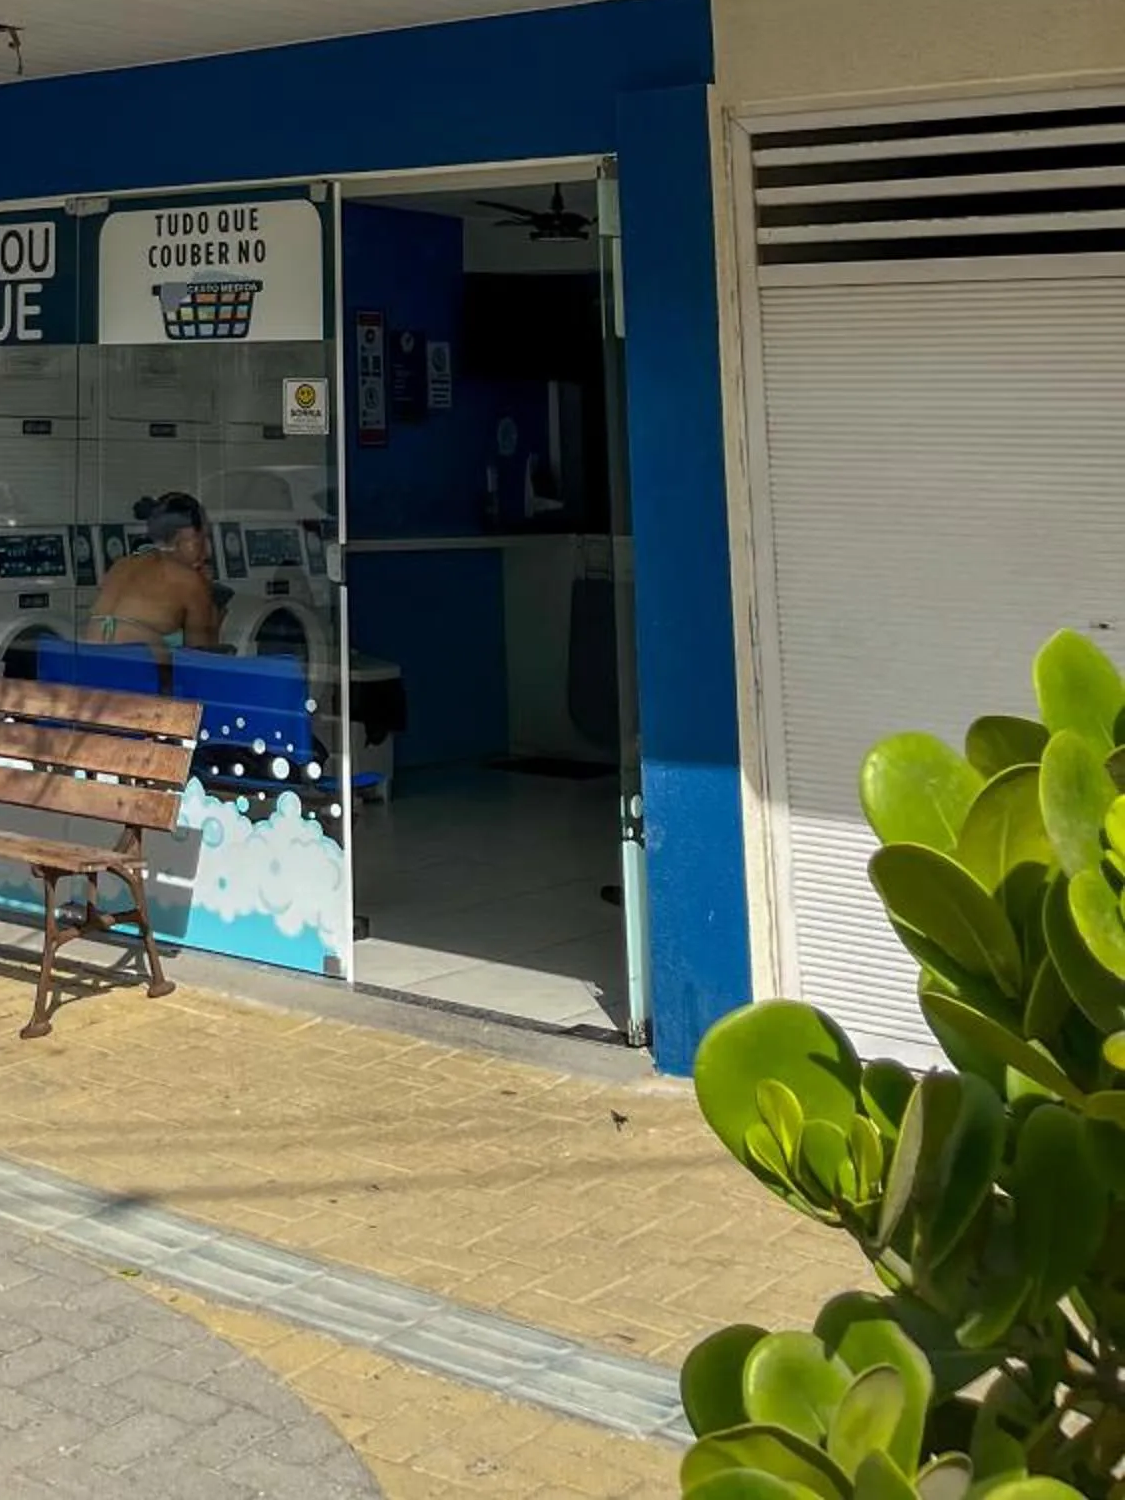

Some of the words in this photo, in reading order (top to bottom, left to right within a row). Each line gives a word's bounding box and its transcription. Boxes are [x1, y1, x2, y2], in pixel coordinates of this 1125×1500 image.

[155, 211, 209, 237] TUDO
[218, 208, 259, 233] QUE
[0, 228, 49, 275] OU
[148, 240, 230, 268] COUBER
[238, 239, 266, 264] NO
